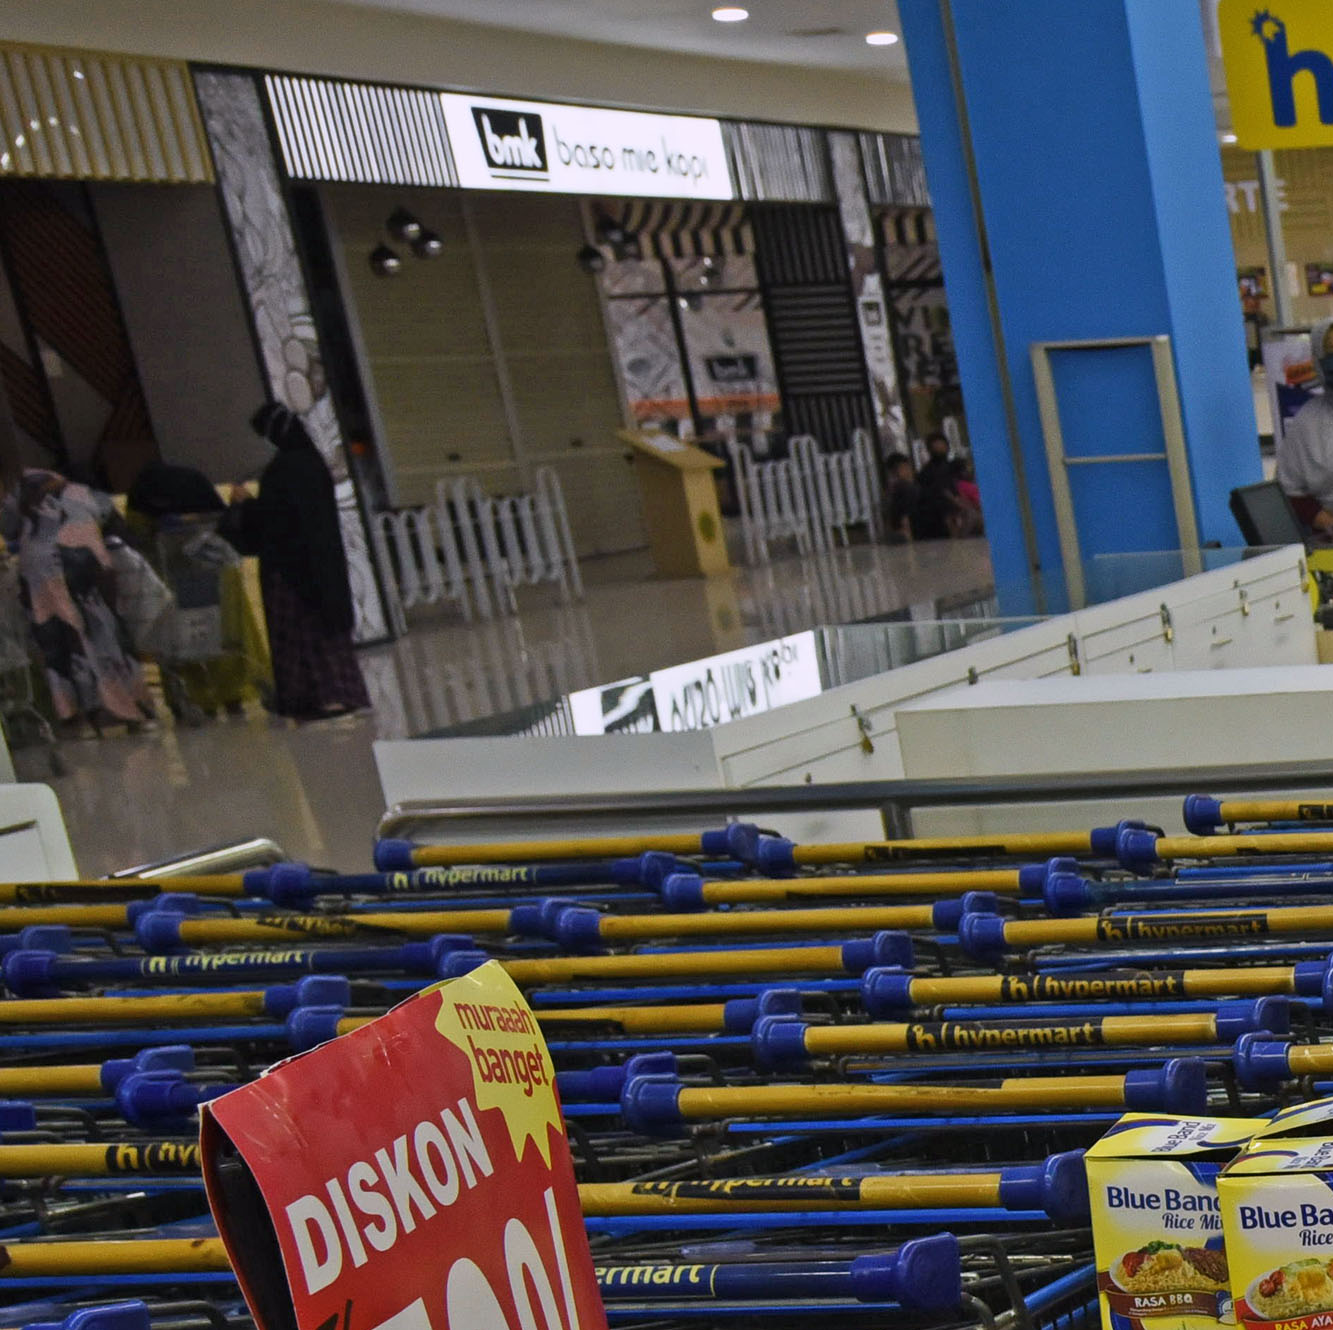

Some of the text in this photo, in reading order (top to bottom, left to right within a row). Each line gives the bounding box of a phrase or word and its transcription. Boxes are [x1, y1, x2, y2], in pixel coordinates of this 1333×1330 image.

[479, 112, 543, 169] bmk
[551, 124, 615, 170] baso
[454, 1000, 537, 1037] muraaah
[467, 1035, 550, 1098] banget
[285, 1098, 495, 1297] DISKON
[1239, 1205, 1298, 1231] Blue
[1298, 1228, 1333, 1247] Rice
